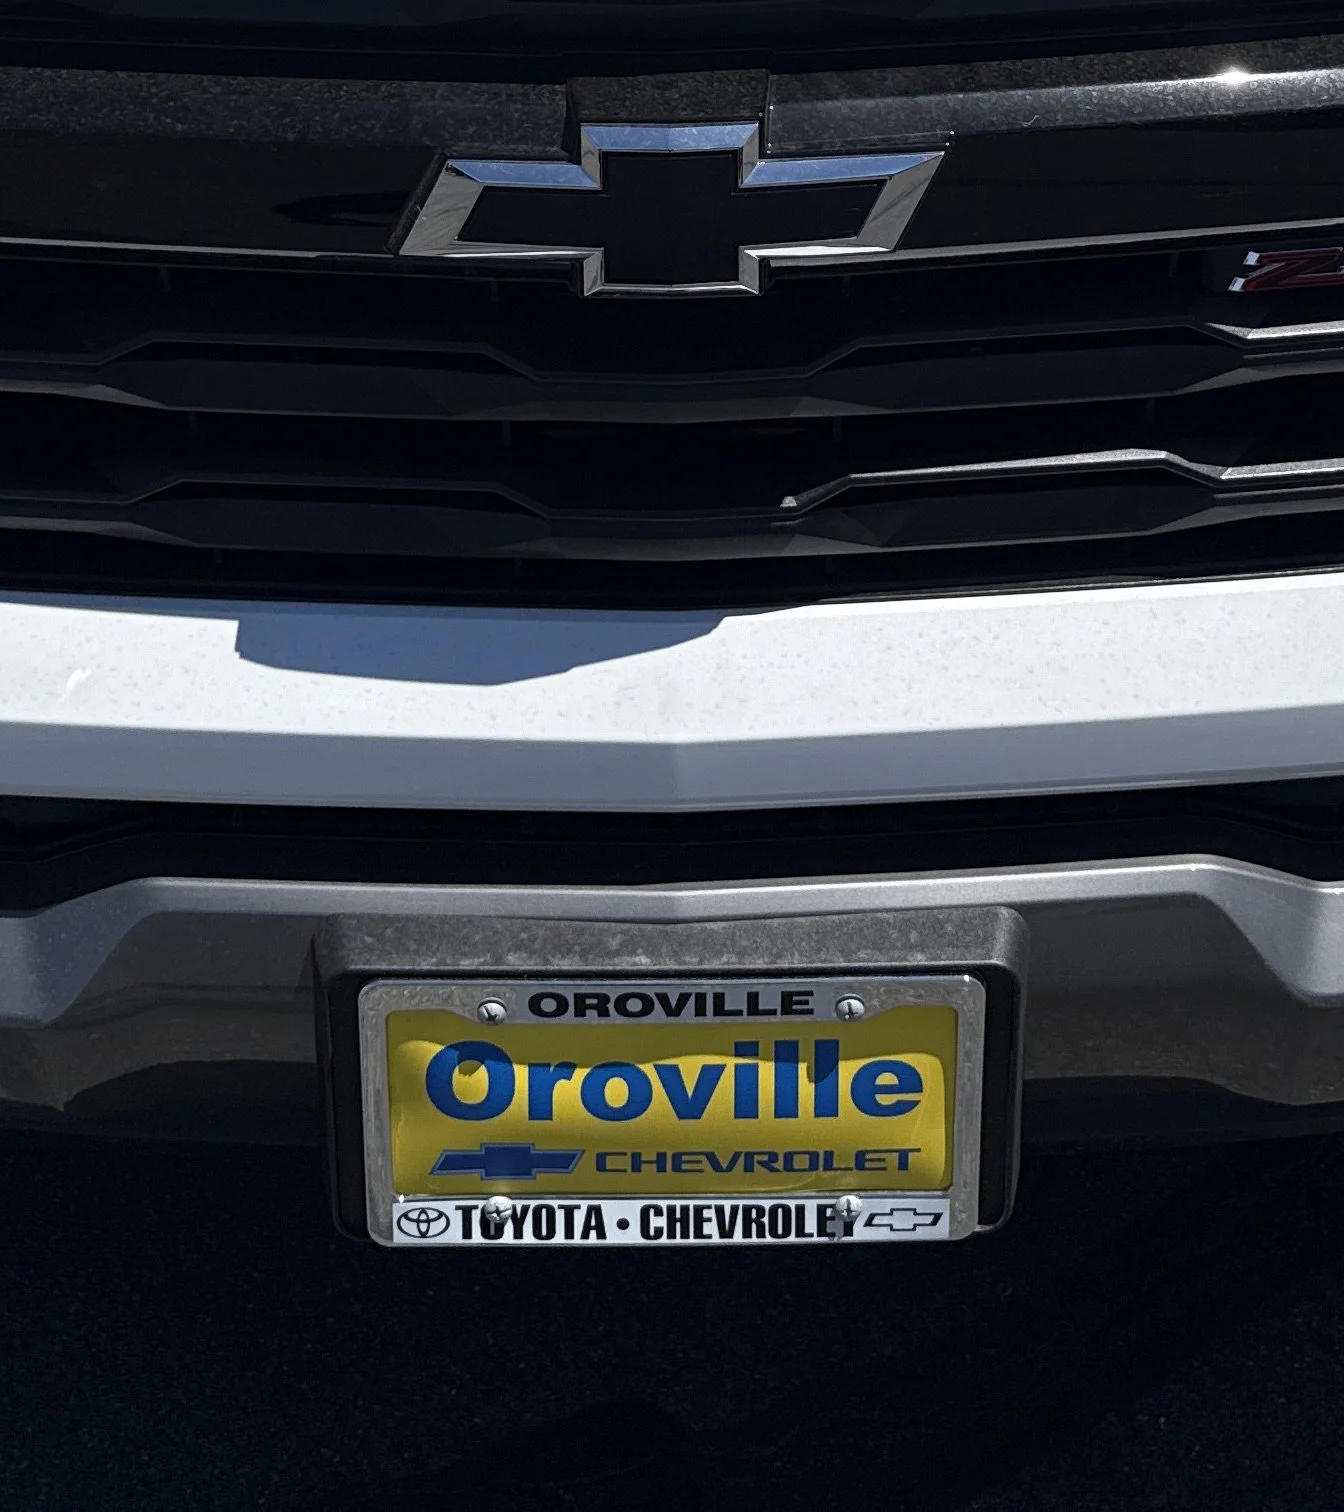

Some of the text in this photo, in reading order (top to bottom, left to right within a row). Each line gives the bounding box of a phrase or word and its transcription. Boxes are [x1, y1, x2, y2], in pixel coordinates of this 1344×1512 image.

[527, 989, 815, 1018] OROVILLE
[425, 1039, 924, 1122] Oroville
[595, 1147, 922, 1174] CHEVROLET
